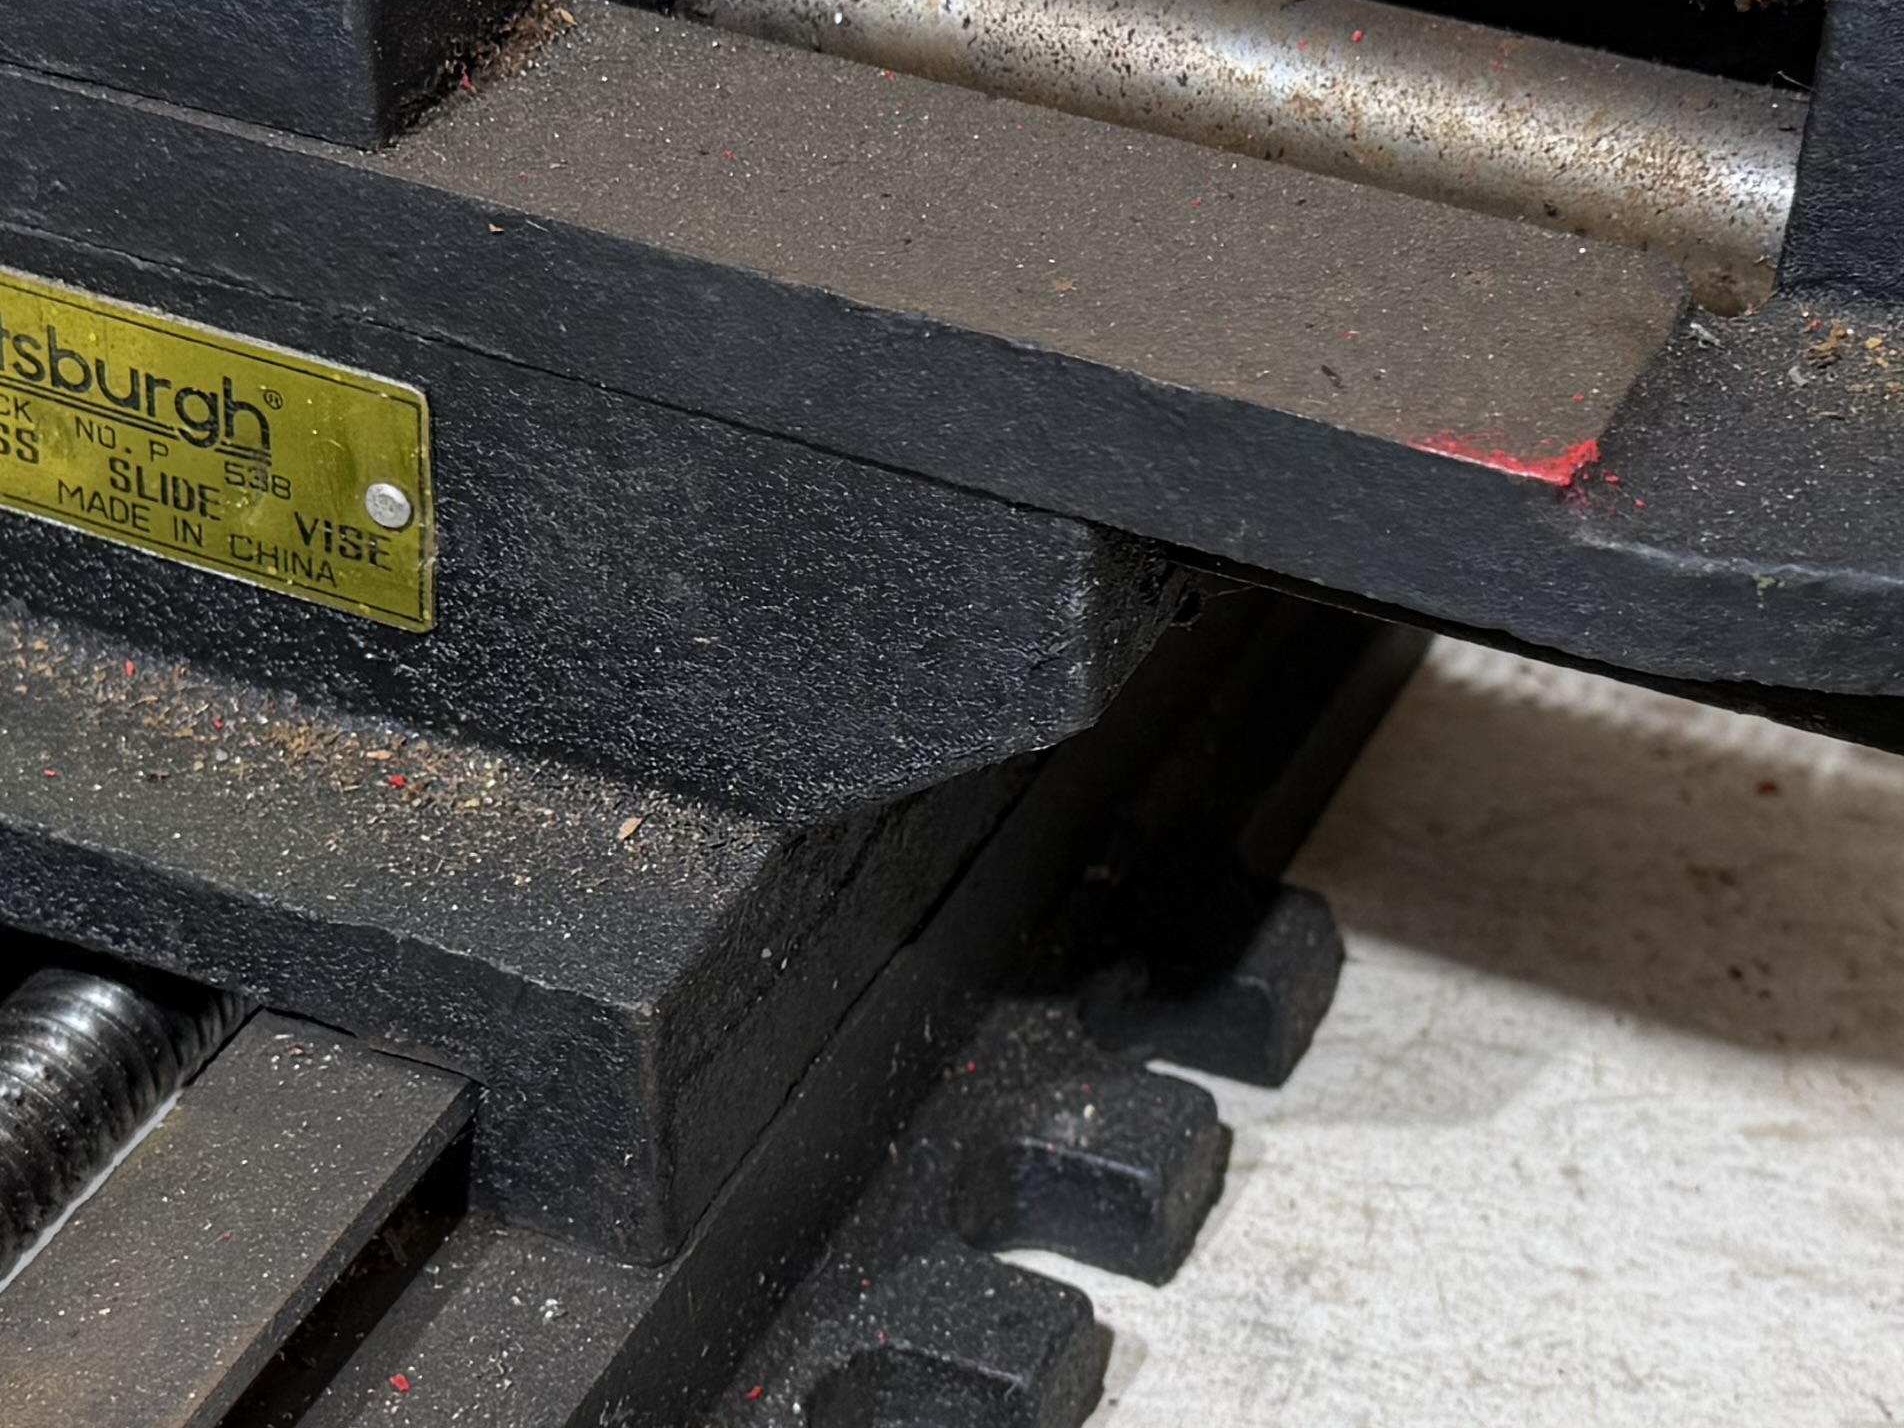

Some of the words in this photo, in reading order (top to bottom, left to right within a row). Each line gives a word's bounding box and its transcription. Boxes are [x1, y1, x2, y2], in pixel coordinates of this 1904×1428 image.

[75, 415, 133, 455] NO.
[149, 439, 170, 463] P
[223, 460, 293, 501] 538
[58, 479, 151, 533] MADE
[173, 515, 204, 548] IN
[229, 532, 337, 589] CHINA
[109, 456, 222, 522] SLIDE
[294, 511, 393, 572] VISE
